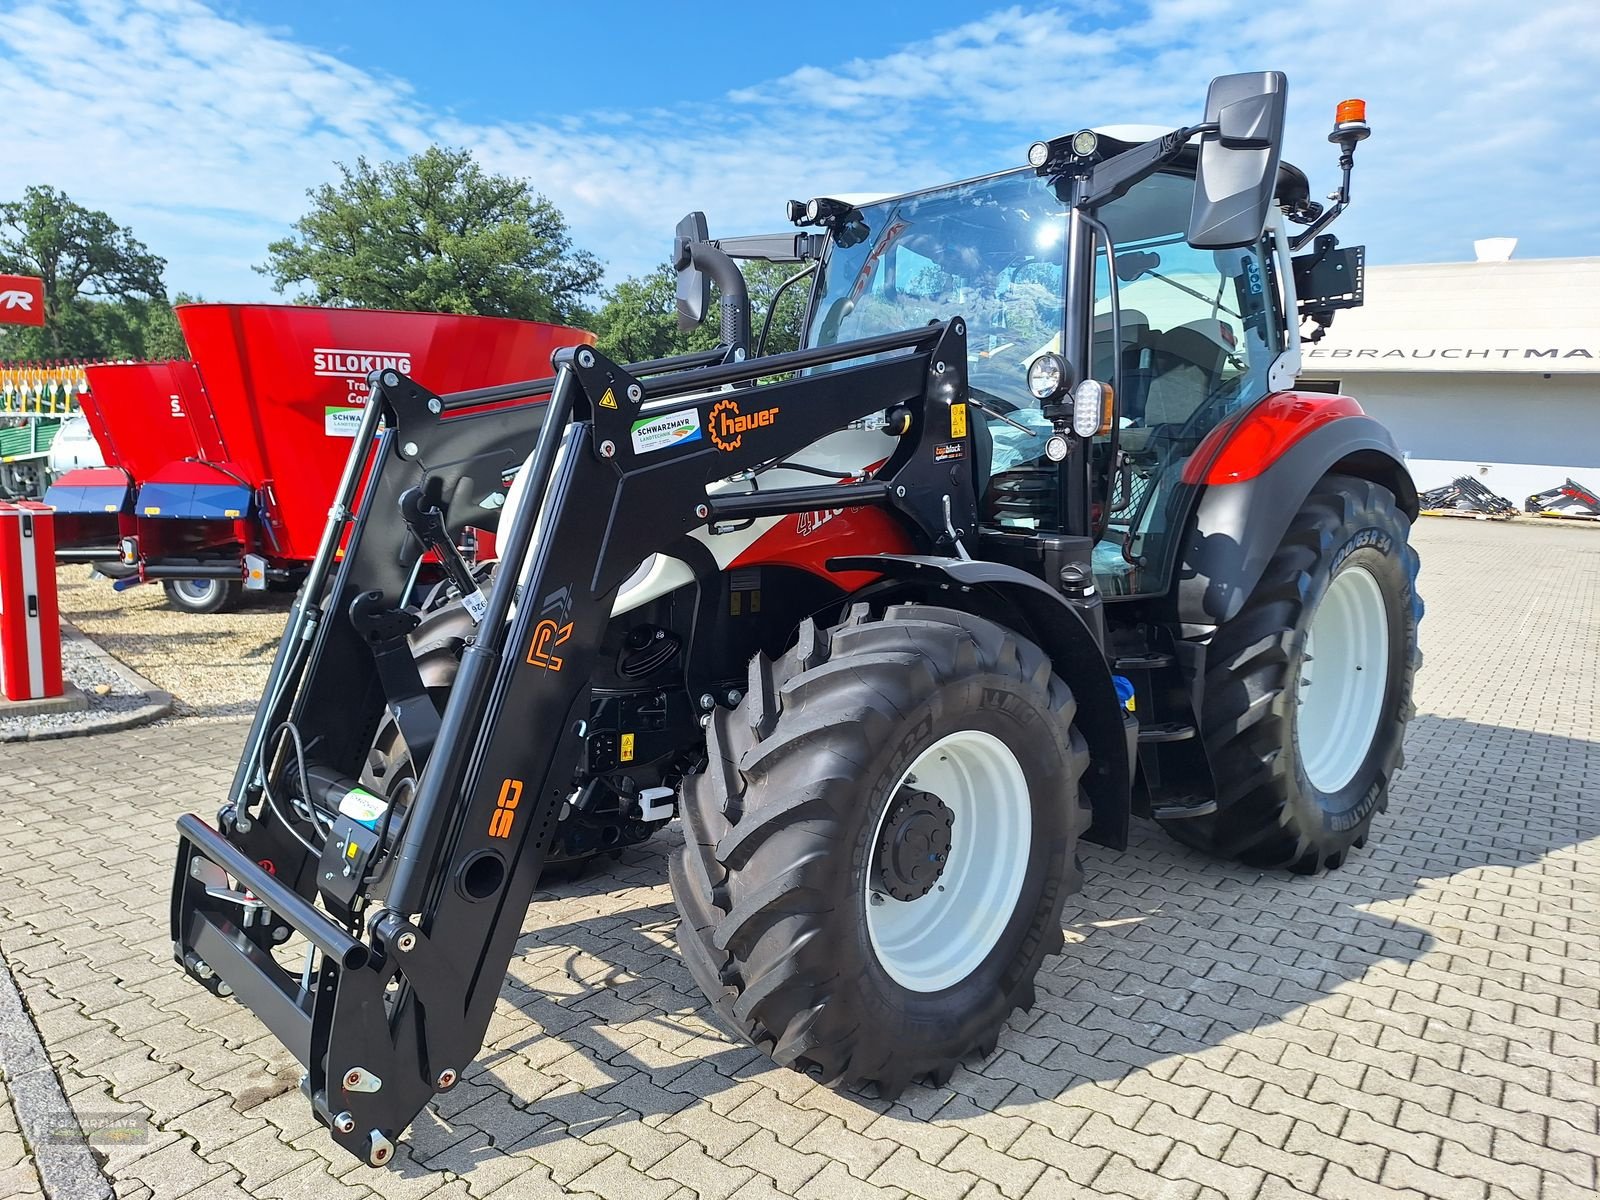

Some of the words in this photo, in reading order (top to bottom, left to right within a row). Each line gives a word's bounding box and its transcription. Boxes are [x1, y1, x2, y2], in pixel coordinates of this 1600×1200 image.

[1300, 348, 1600, 359] EBRAUCHTMA
[314, 354, 411, 374] SILOKING
[332, 413, 361, 423] SCHWA
[637, 418, 690, 436] SCHWARZMAYR
[721, 407, 780, 436] hauer
